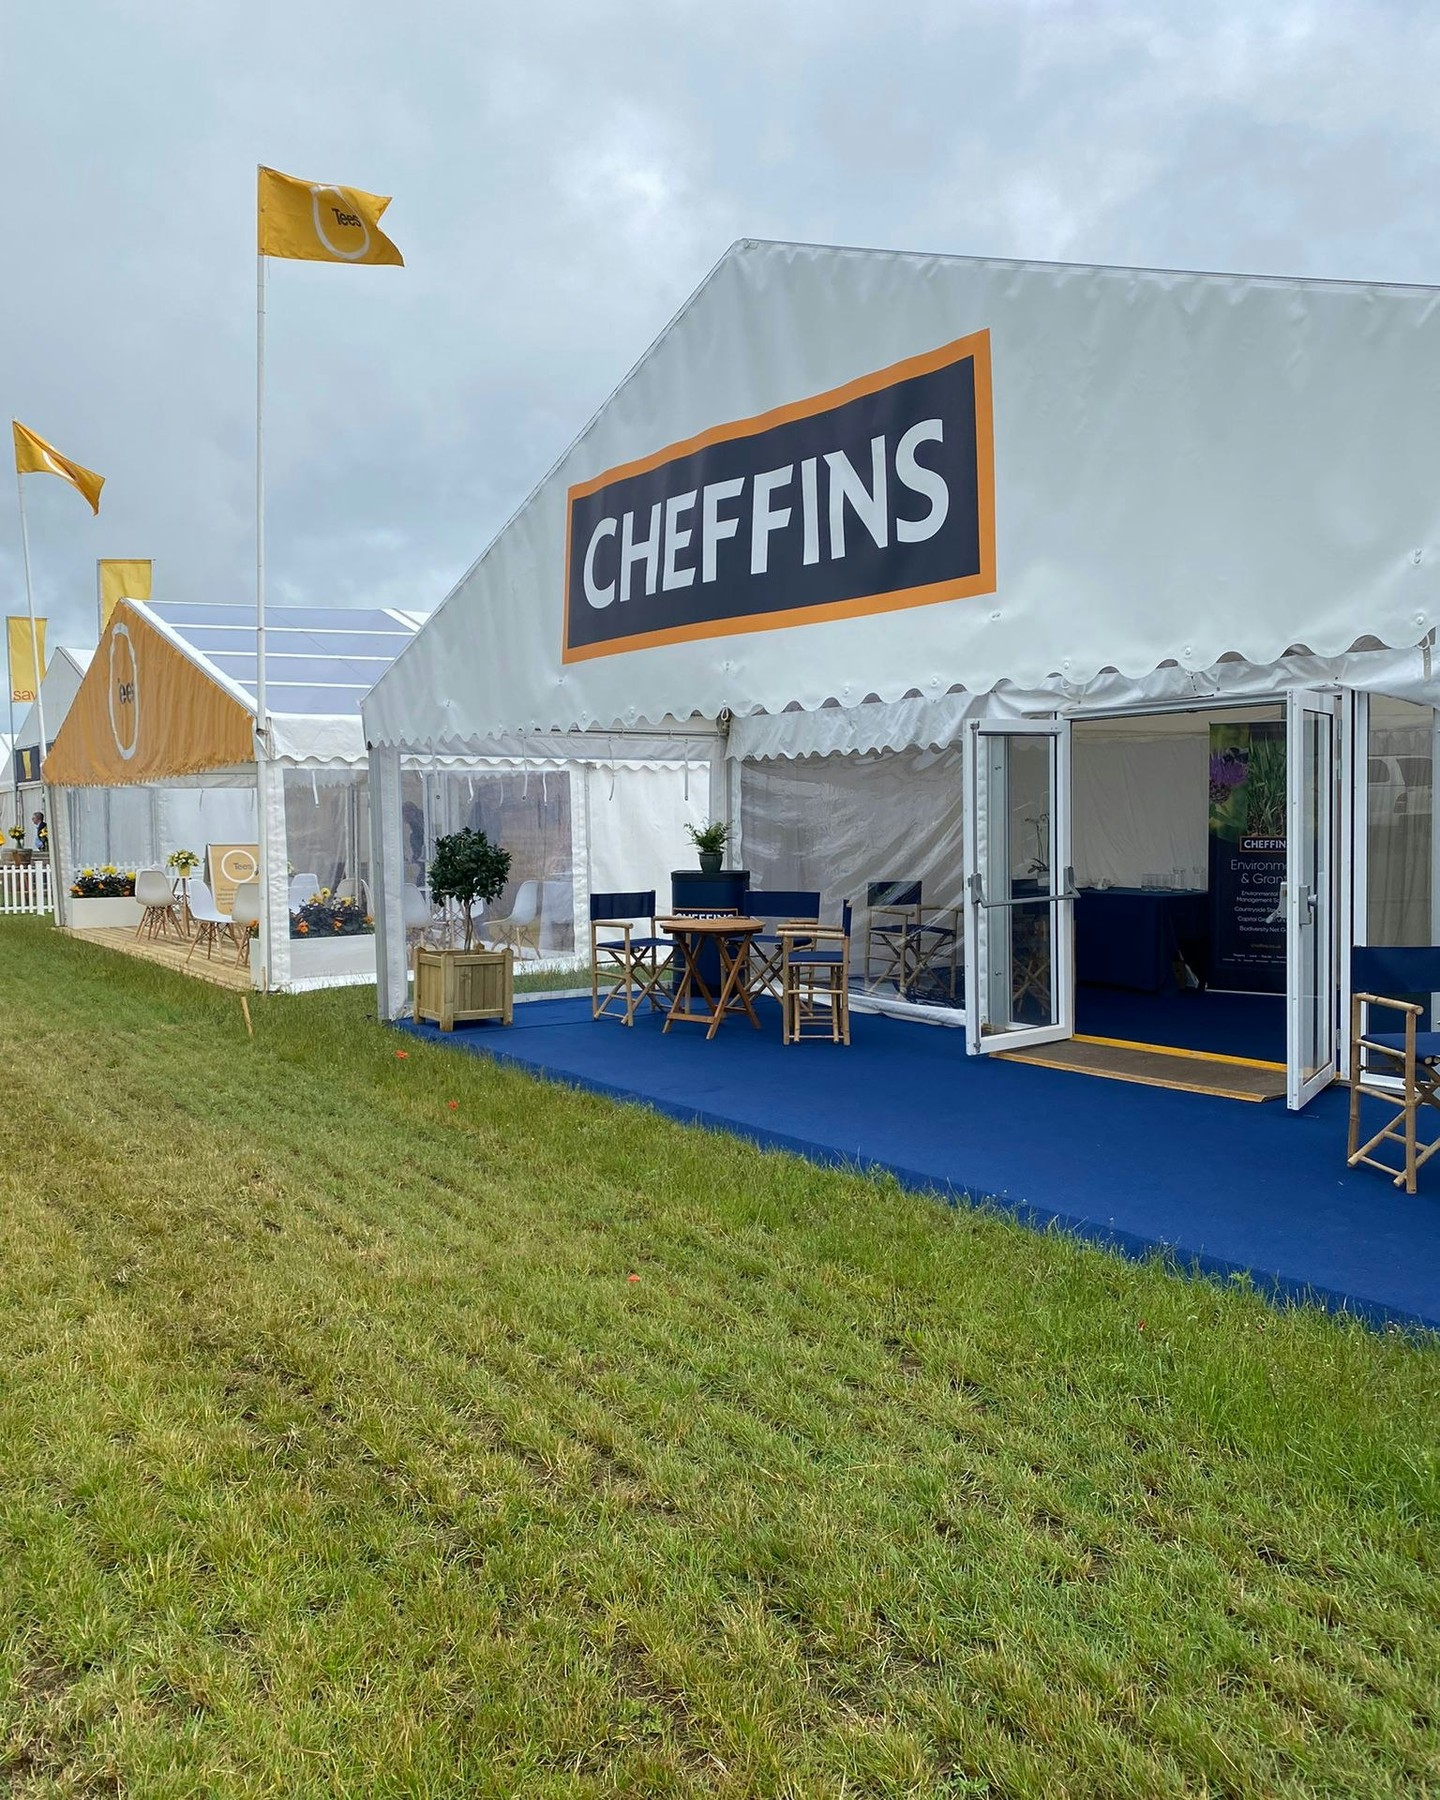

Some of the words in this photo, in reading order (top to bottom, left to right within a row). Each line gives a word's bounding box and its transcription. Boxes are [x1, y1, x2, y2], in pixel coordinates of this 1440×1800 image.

[331, 208, 361, 228] Tees
[583, 419, 949, 609] CHEFFINS
[117, 677, 135, 704] ee
[1230, 859, 1286, 871] Environm
[1240, 873, 1249, 884] &
